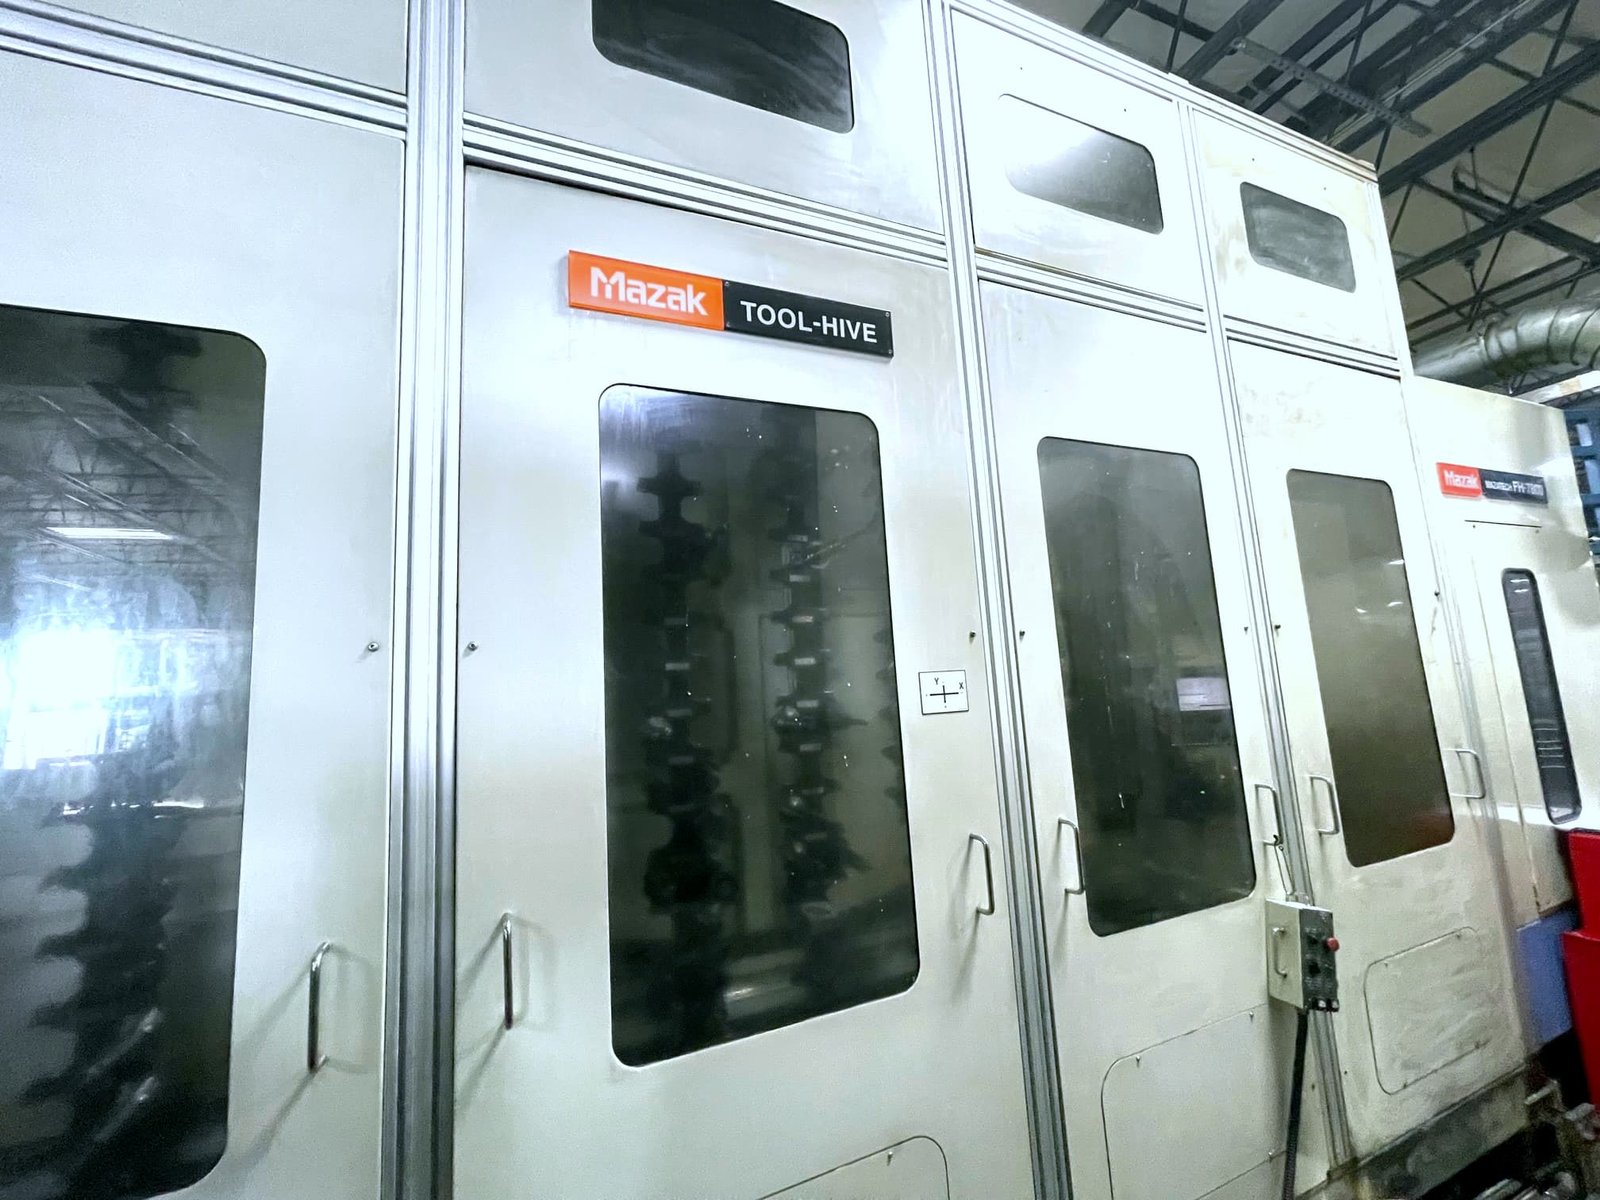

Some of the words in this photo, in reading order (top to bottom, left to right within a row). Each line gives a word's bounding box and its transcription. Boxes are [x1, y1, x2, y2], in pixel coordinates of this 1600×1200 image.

[590, 267, 708, 314] Mazak
[740, 301, 877, 343] TOOL-HIVE
[1443, 470, 1478, 488] Mazak
[934, 677, 939, 685] Y
